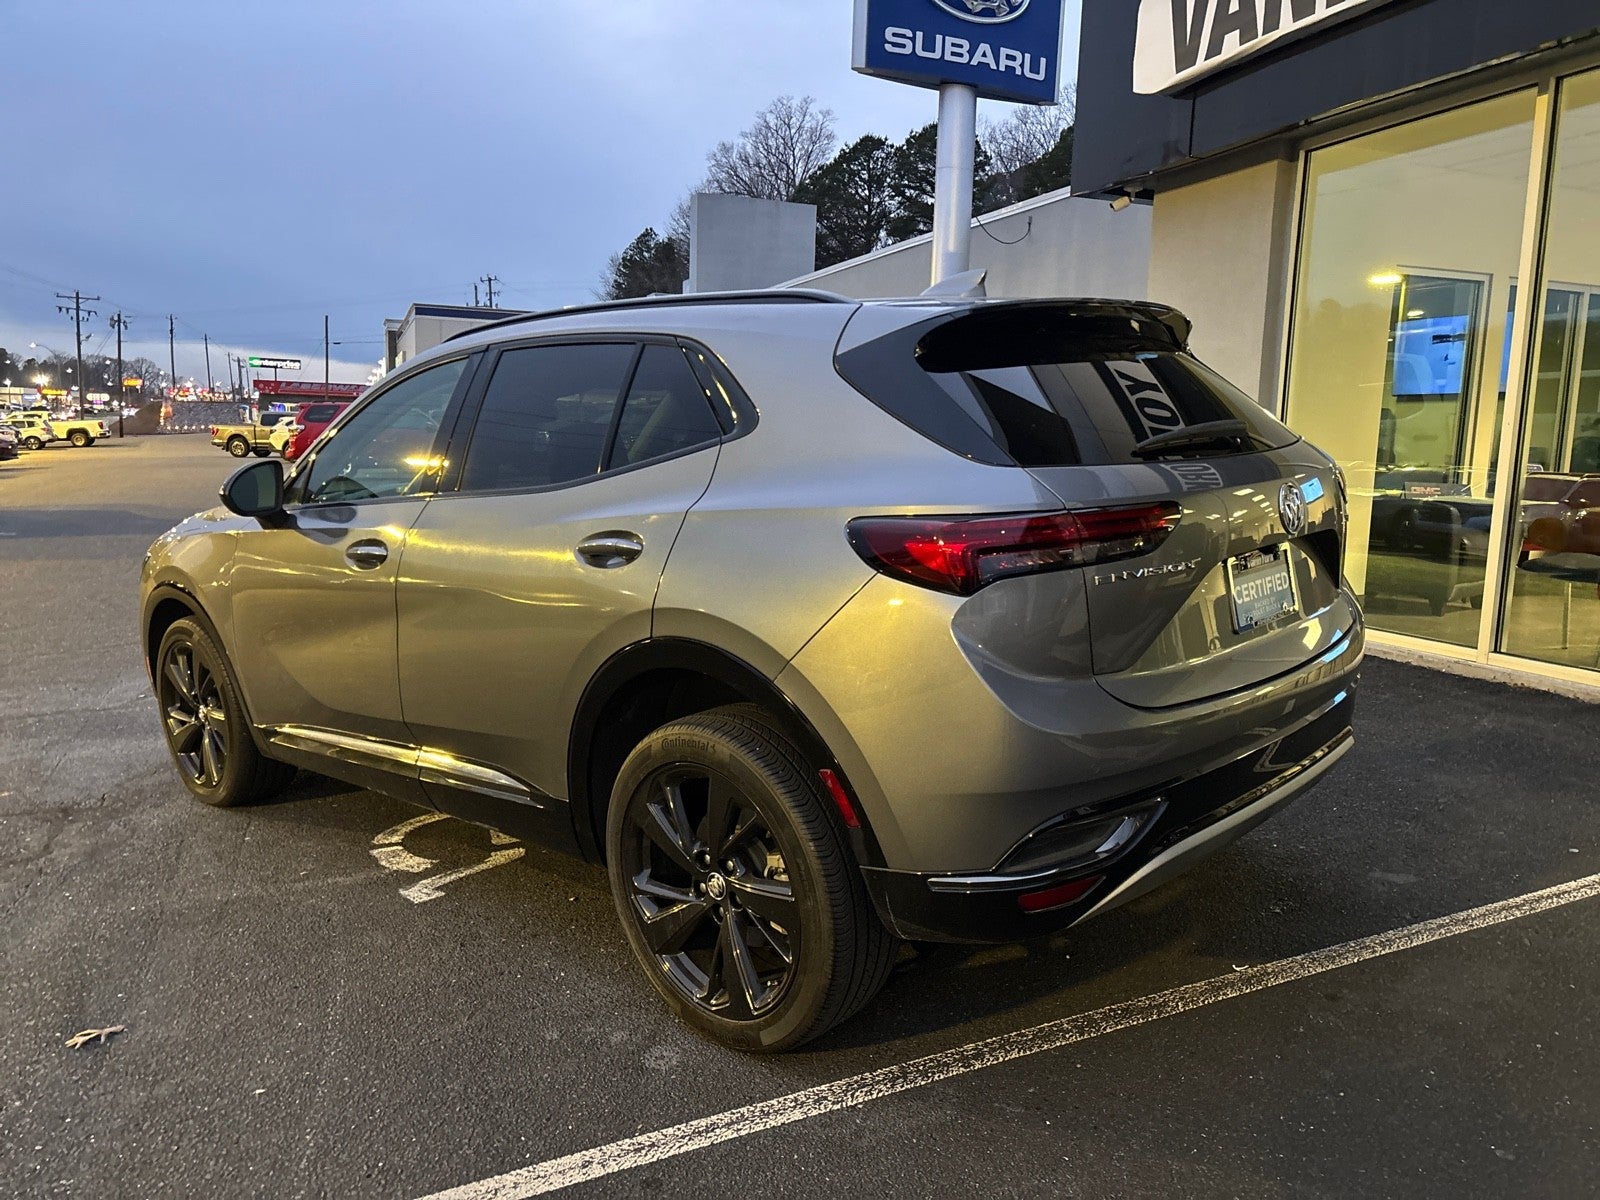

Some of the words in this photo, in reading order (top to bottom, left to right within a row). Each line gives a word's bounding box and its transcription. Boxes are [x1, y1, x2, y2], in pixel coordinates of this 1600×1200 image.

[884, 26, 1047, 81] SUBARU
[1410, 486, 1441, 495] GMC
[1234, 571, 1290, 605] CERTIFIED
[661, 736, 709, 751] Continental
